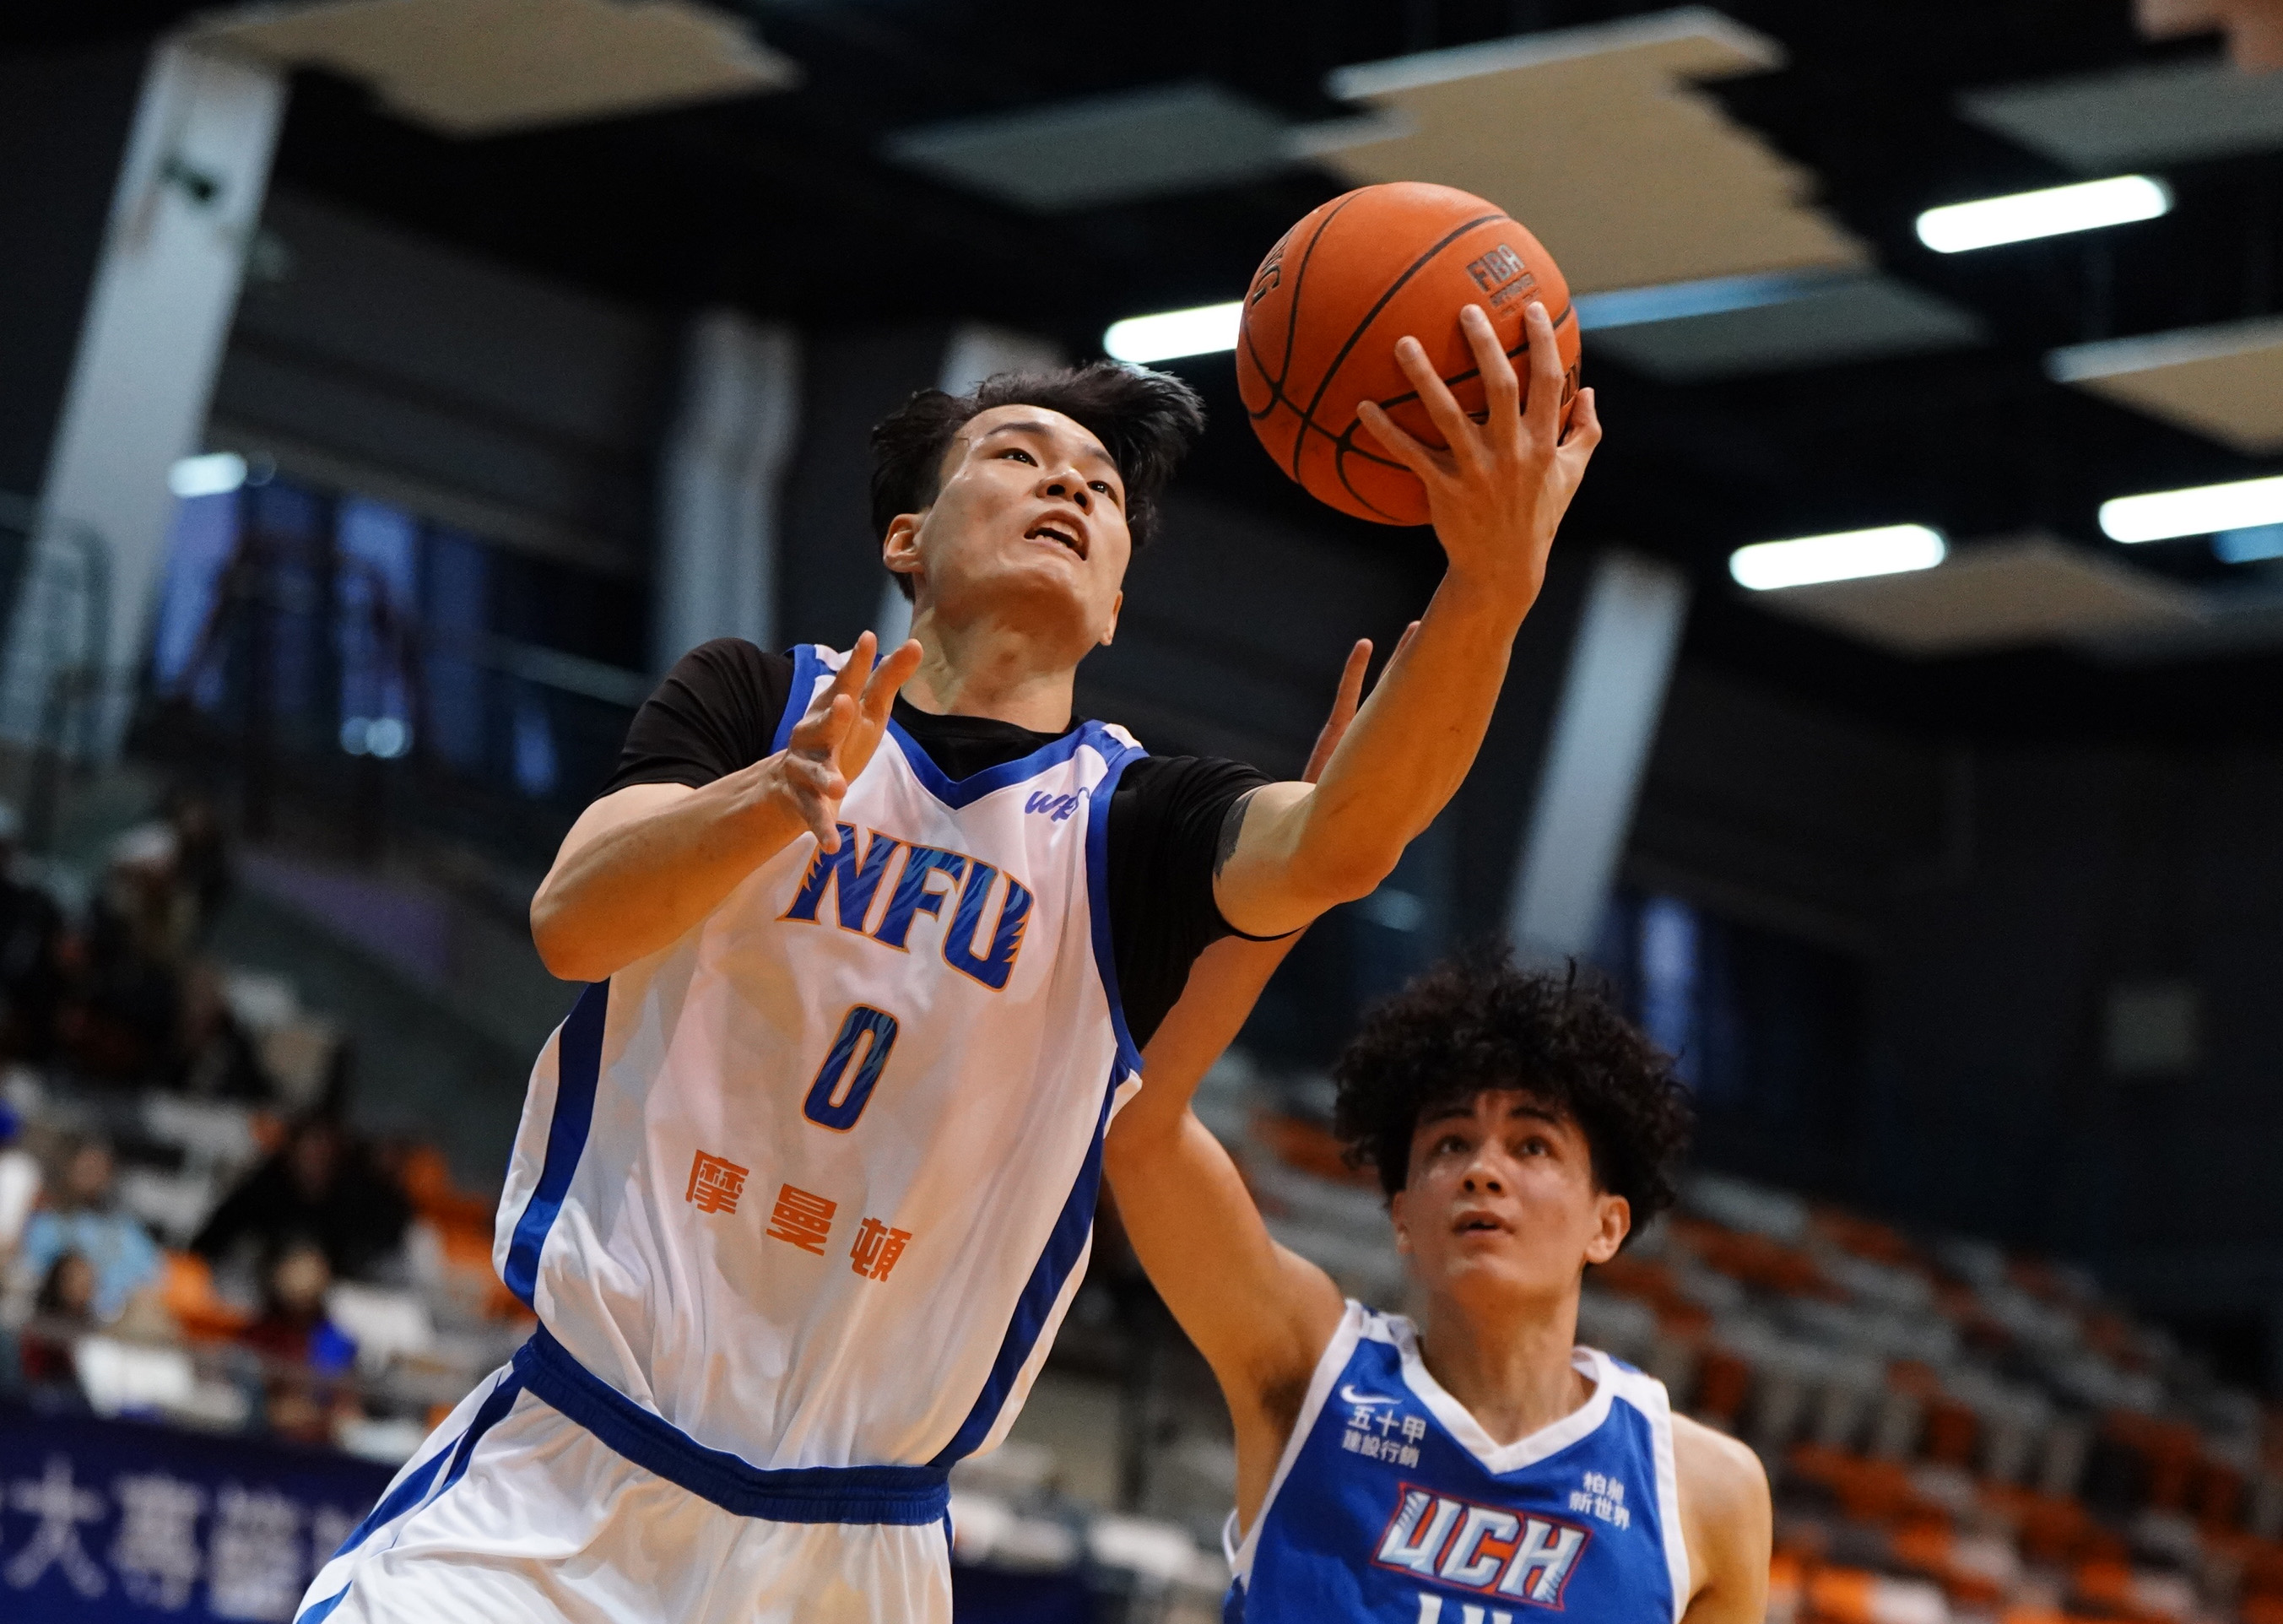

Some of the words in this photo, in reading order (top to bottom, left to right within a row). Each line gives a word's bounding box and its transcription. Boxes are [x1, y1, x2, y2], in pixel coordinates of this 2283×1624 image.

[1466, 242, 1525, 293] FIBA
[774, 823, 1035, 993] NFU
[802, 1003, 901, 1134] 0
[685, 1149, 913, 1282] 摩曼頓
[1347, 1405, 1426, 1444] 五十甲
[1375, 1488, 1588, 1607] UCH
[1569, 1491, 1631, 1530] 新世界
